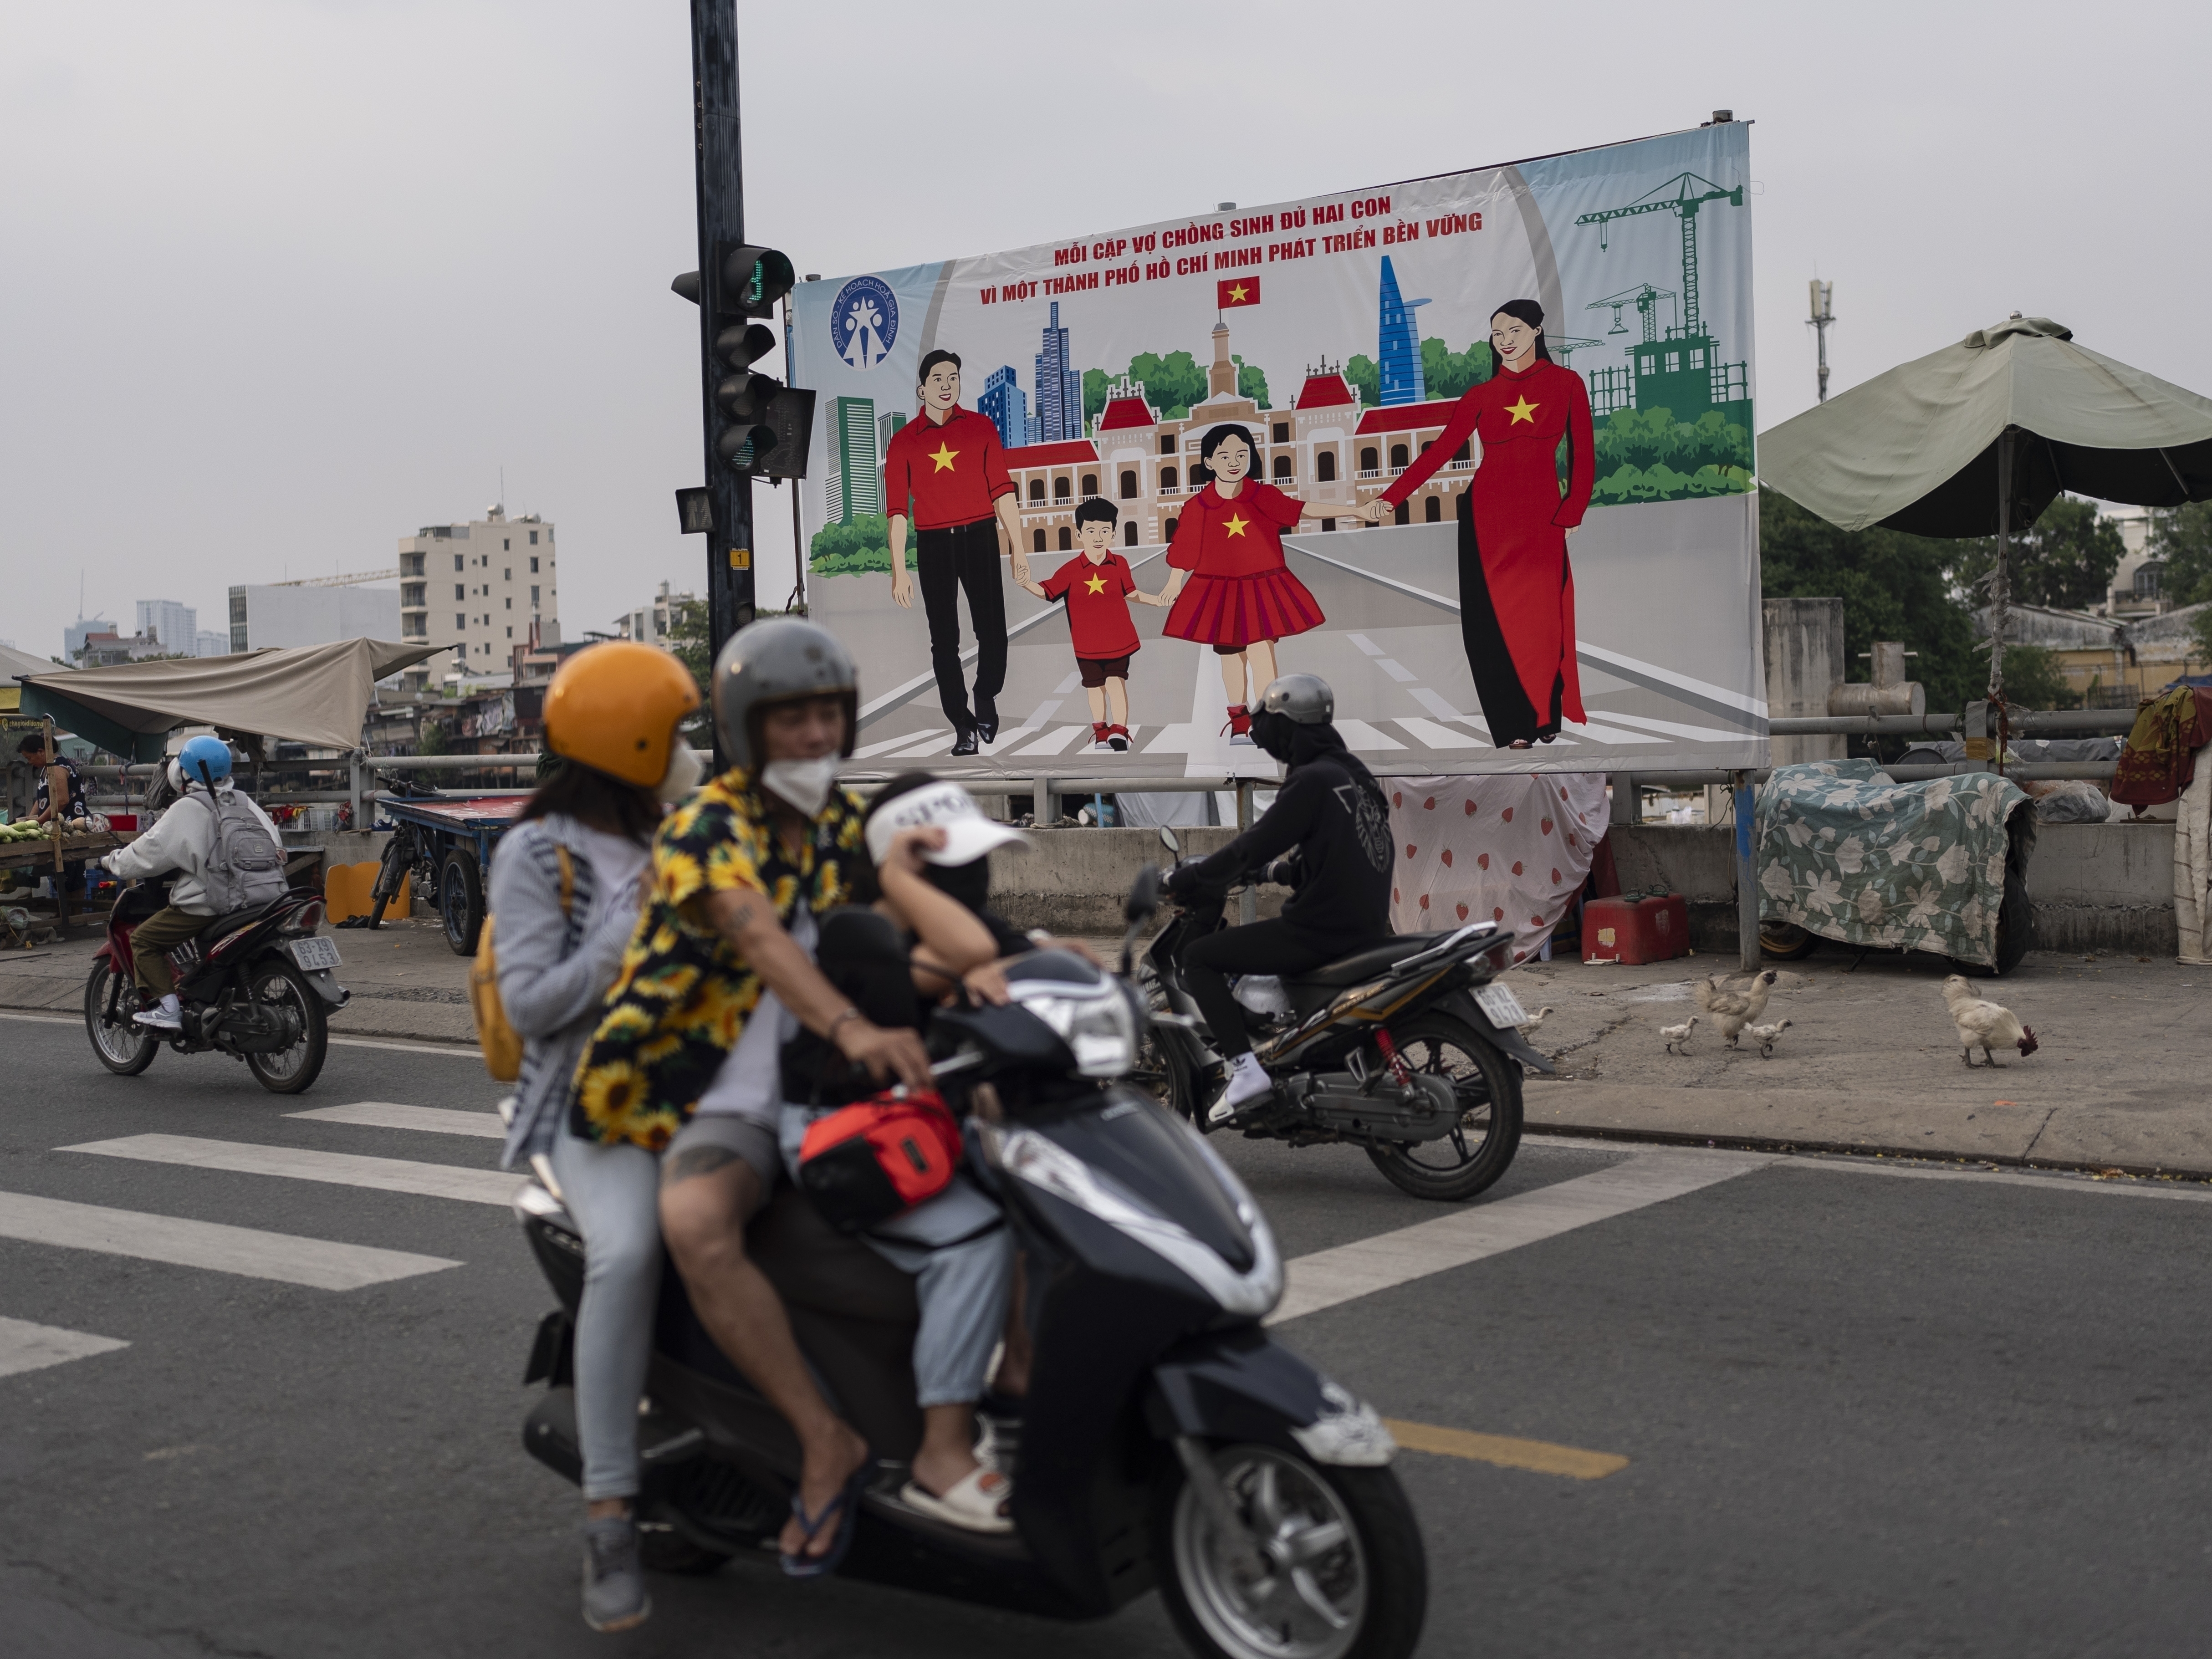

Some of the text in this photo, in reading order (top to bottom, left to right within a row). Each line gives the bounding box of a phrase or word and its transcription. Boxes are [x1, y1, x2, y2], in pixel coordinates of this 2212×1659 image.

[1054, 196, 1391, 266] MỖI CẶP VỢ CHỒNG SINH ĐỦ HAI CON
[980, 212, 1482, 305] VÌ MỘT THÀNH PHỐ HỒ CHÍ MINH PHÁT TRIỂN BỀN VỮNG
[737, 553, 742, 564] 1
[303, 952, 335, 967] 9453
